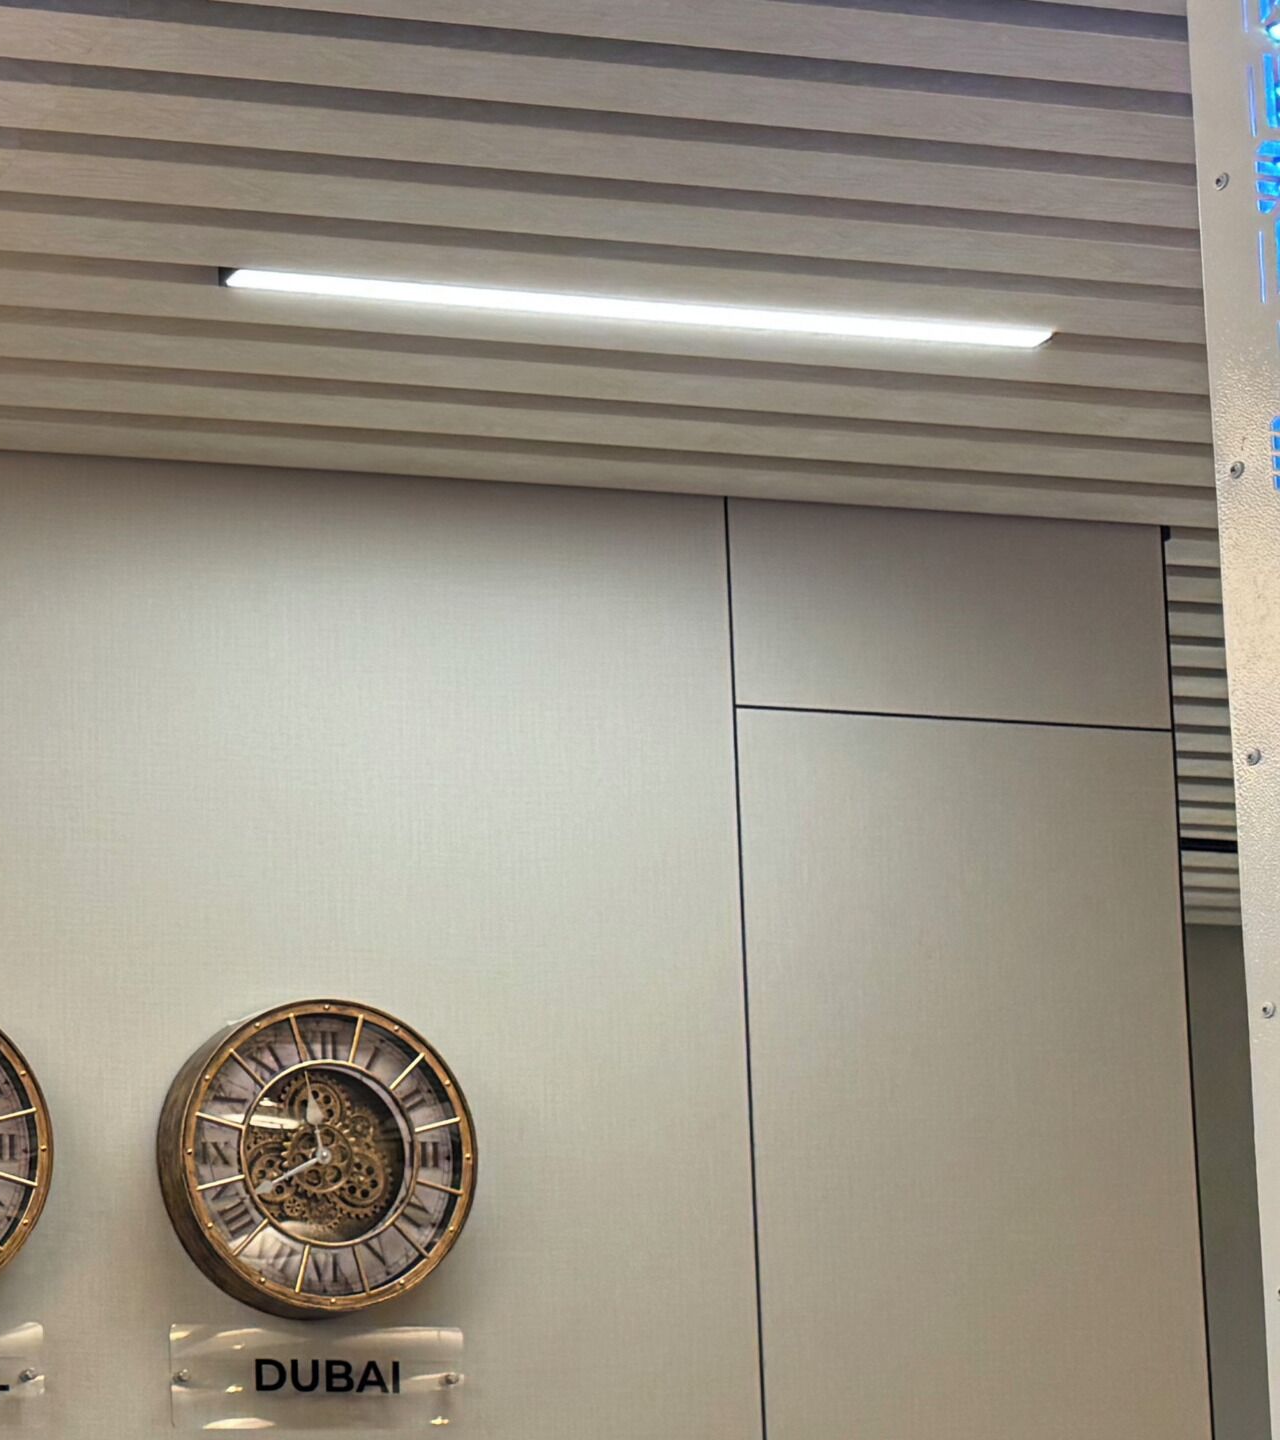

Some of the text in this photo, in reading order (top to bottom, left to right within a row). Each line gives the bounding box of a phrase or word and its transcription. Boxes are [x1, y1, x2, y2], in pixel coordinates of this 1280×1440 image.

[200, 1140, 231, 1167] IX
[312, 1252, 339, 1283] VI
[255, 1358, 400, 1394] DUBAI
